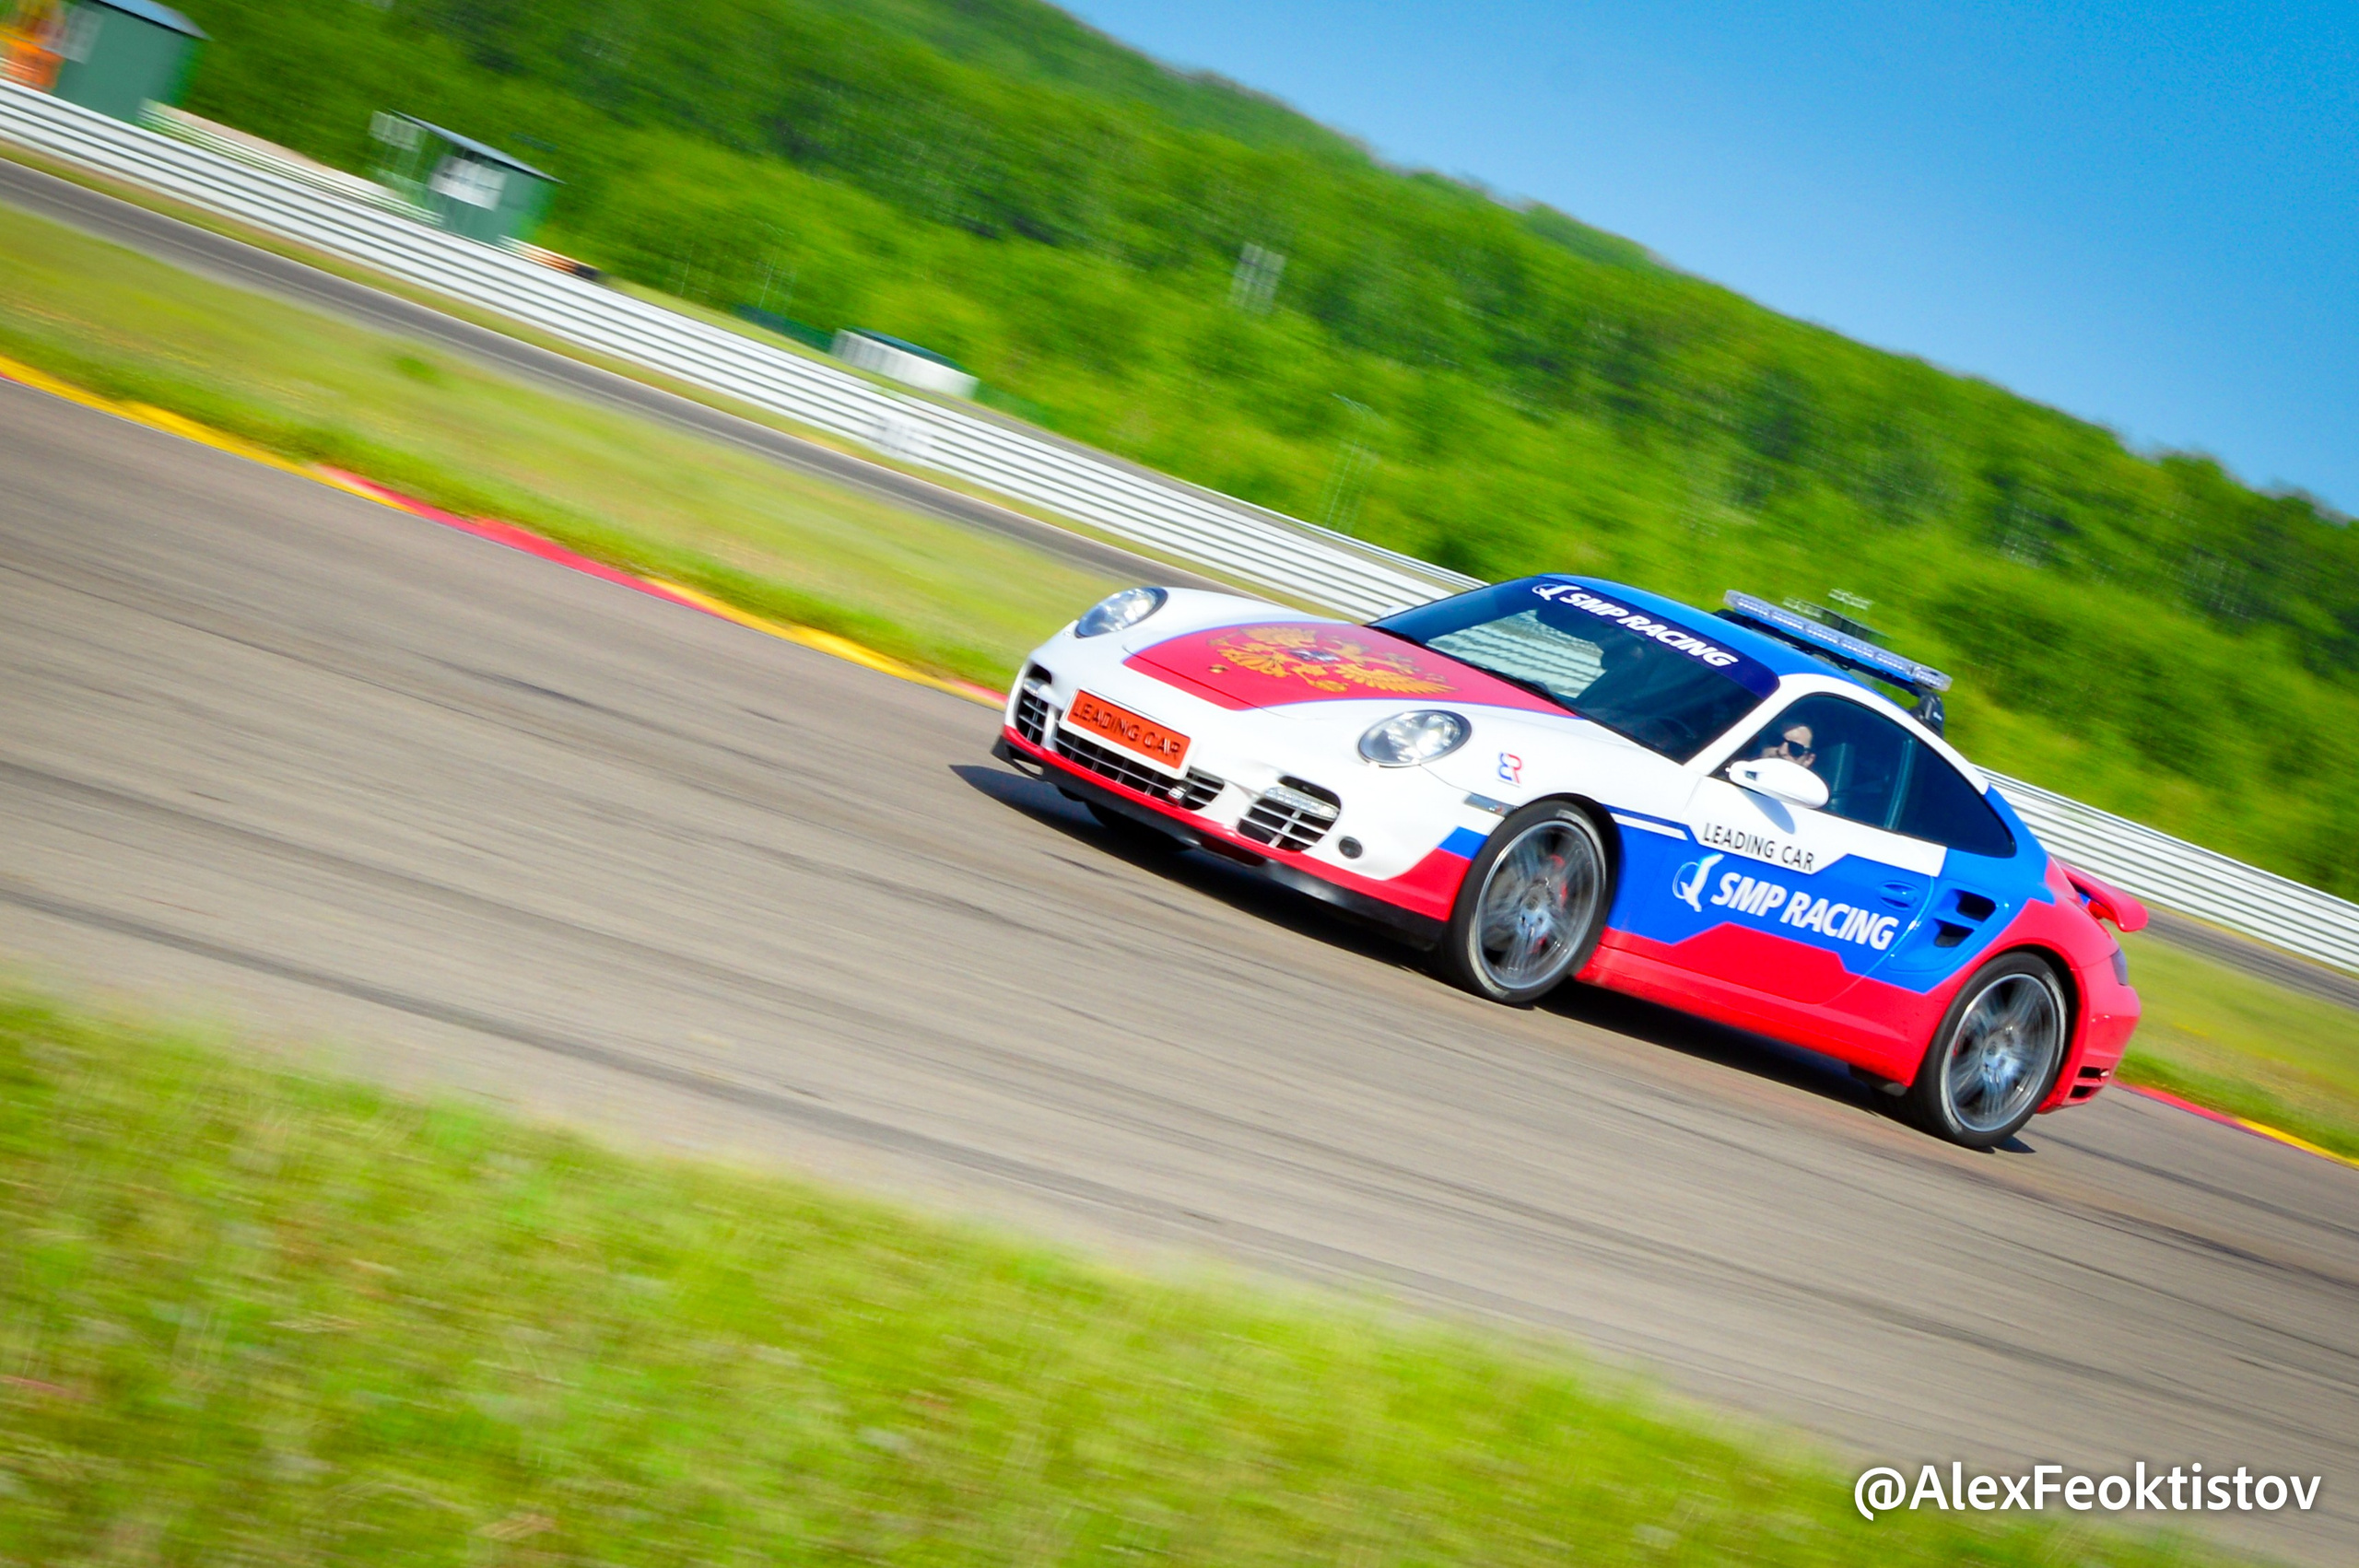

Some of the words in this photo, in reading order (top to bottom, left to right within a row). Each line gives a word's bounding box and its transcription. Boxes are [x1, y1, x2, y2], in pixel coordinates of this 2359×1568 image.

[1559, 592, 1628, 618] SMP
[1614, 614, 1739, 667] RACING
[1143, 731, 1181, 760] CAR
[1703, 823, 1776, 859] LEADING
[1781, 846, 1814, 872] CAR
[1710, 872, 1788, 918] SMP
[1779, 891, 1900, 951] RACING
